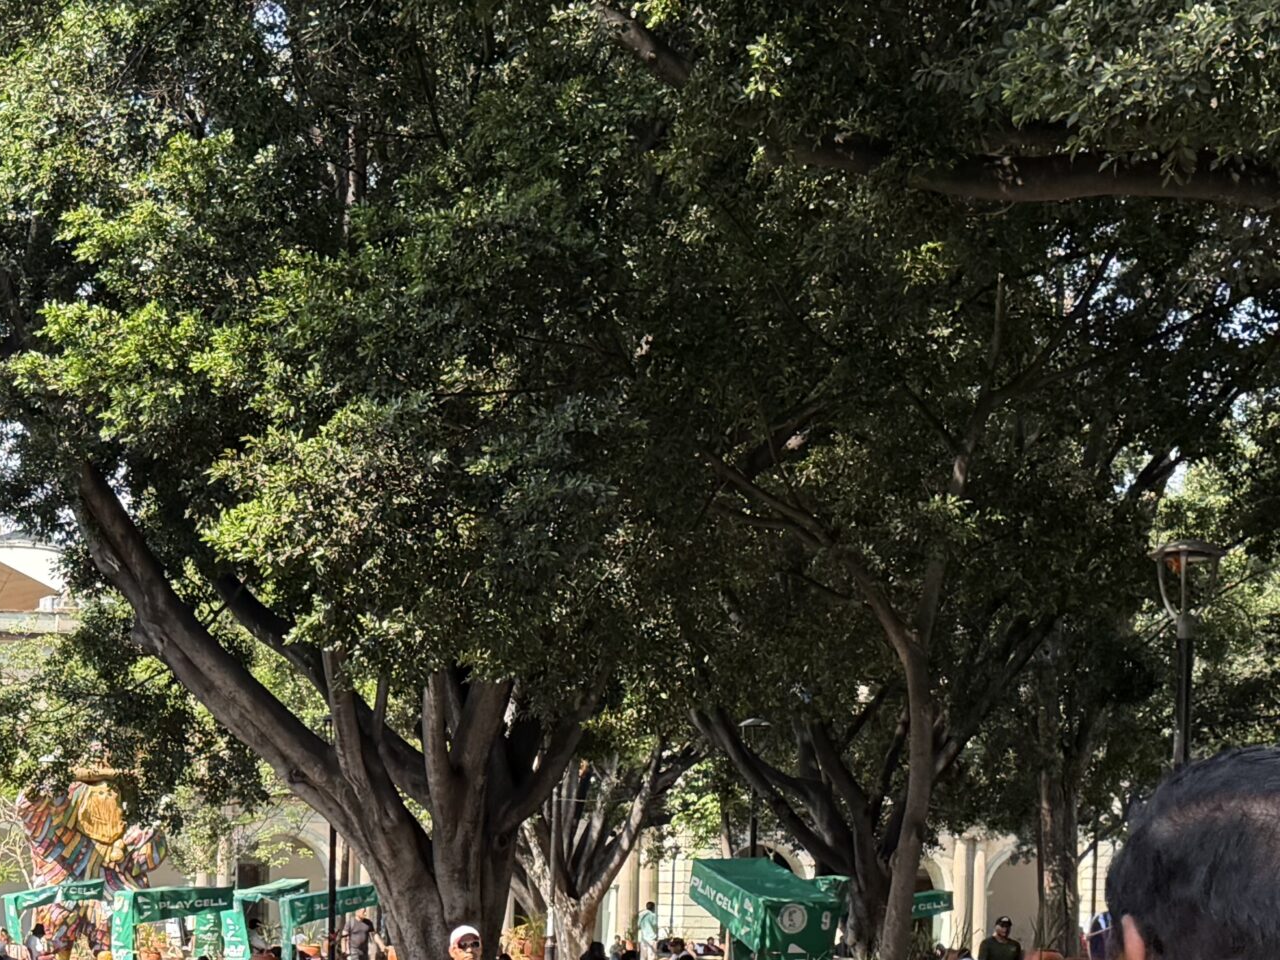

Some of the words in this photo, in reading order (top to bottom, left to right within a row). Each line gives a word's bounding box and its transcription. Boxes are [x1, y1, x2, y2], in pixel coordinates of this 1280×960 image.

[159, 900, 193, 909] PLAY
[194, 898, 227, 908] CELL
[690, 875, 716, 901] PLAY
[715, 892, 740, 918] CELL
[821, 911, 831, 930] 9
